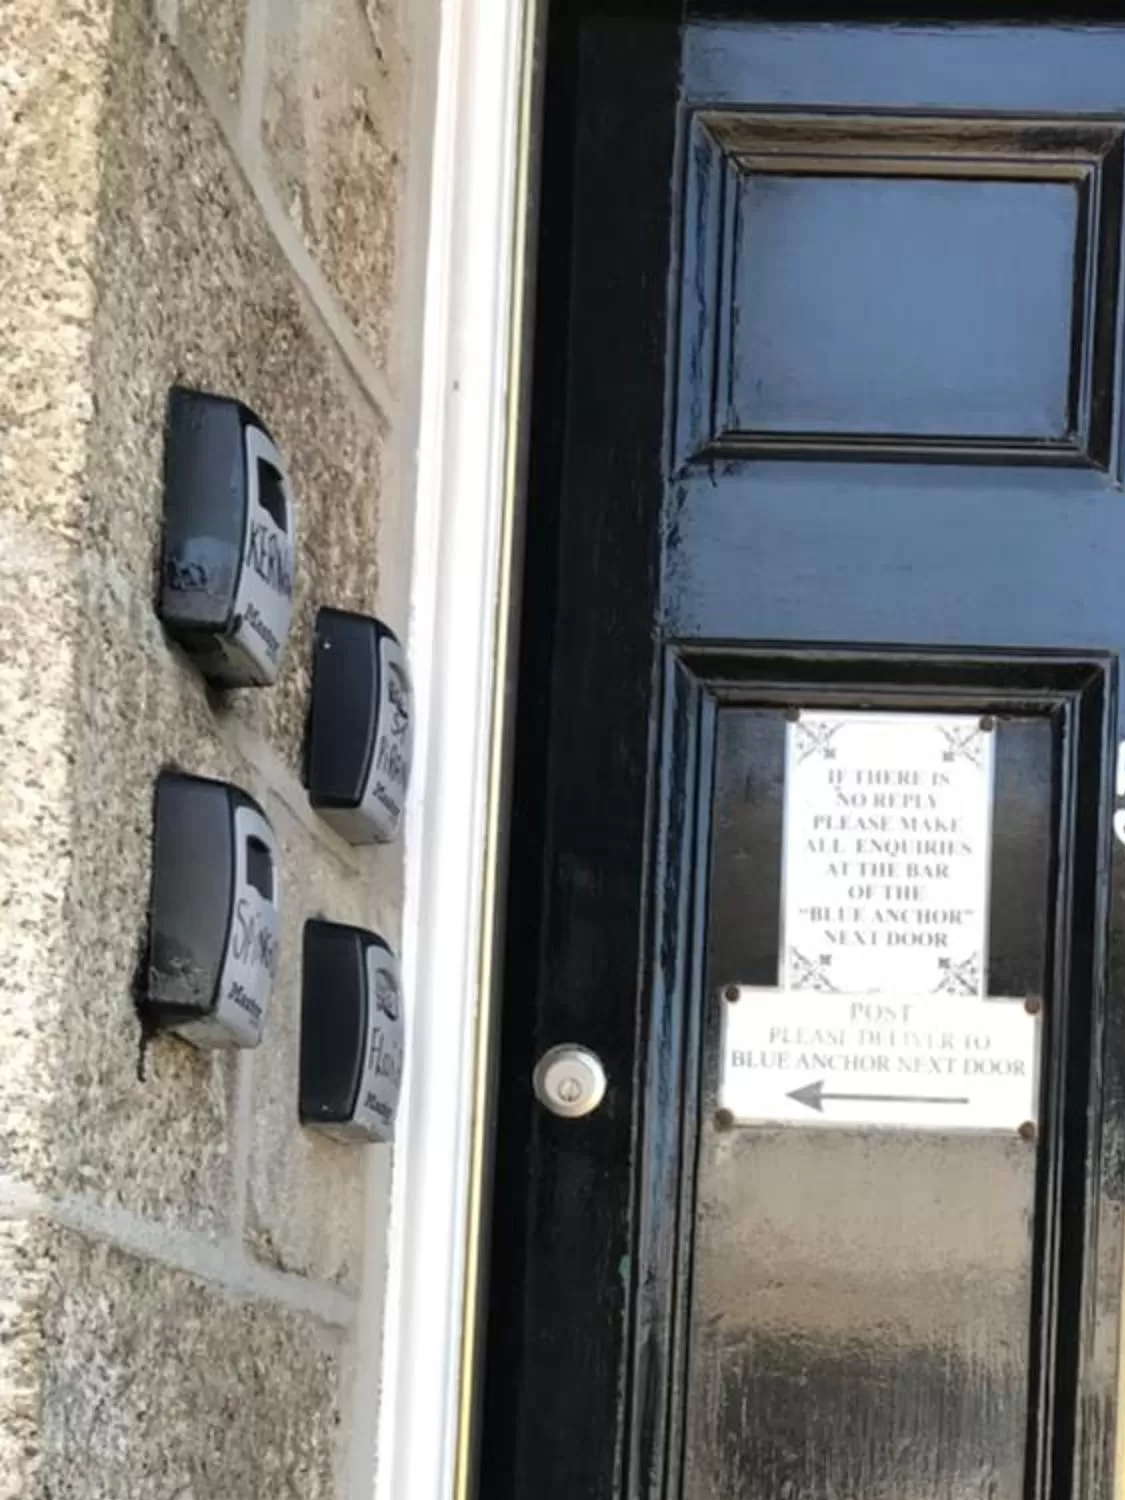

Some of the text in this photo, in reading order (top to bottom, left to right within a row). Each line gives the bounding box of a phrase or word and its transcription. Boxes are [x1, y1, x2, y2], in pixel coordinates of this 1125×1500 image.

[828, 768, 951, 786] IF THERE IS
[835, 792, 938, 809] NO REPLY
[813, 815, 961, 833] PLEASE MAKE
[806, 838, 973, 857] ALL ENQUIRIES
[825, 862, 950, 879] AT THE BAR
[847, 885, 923, 901] OF THE
[823, 929, 949, 947] NEXT DOOR
[849, 1002, 913, 1023] POST
[769, 1026, 992, 1050] PLEASE DELIVER TO
[731, 1050, 1026, 1077] BLUE ANCHOR NEXT DOOR
